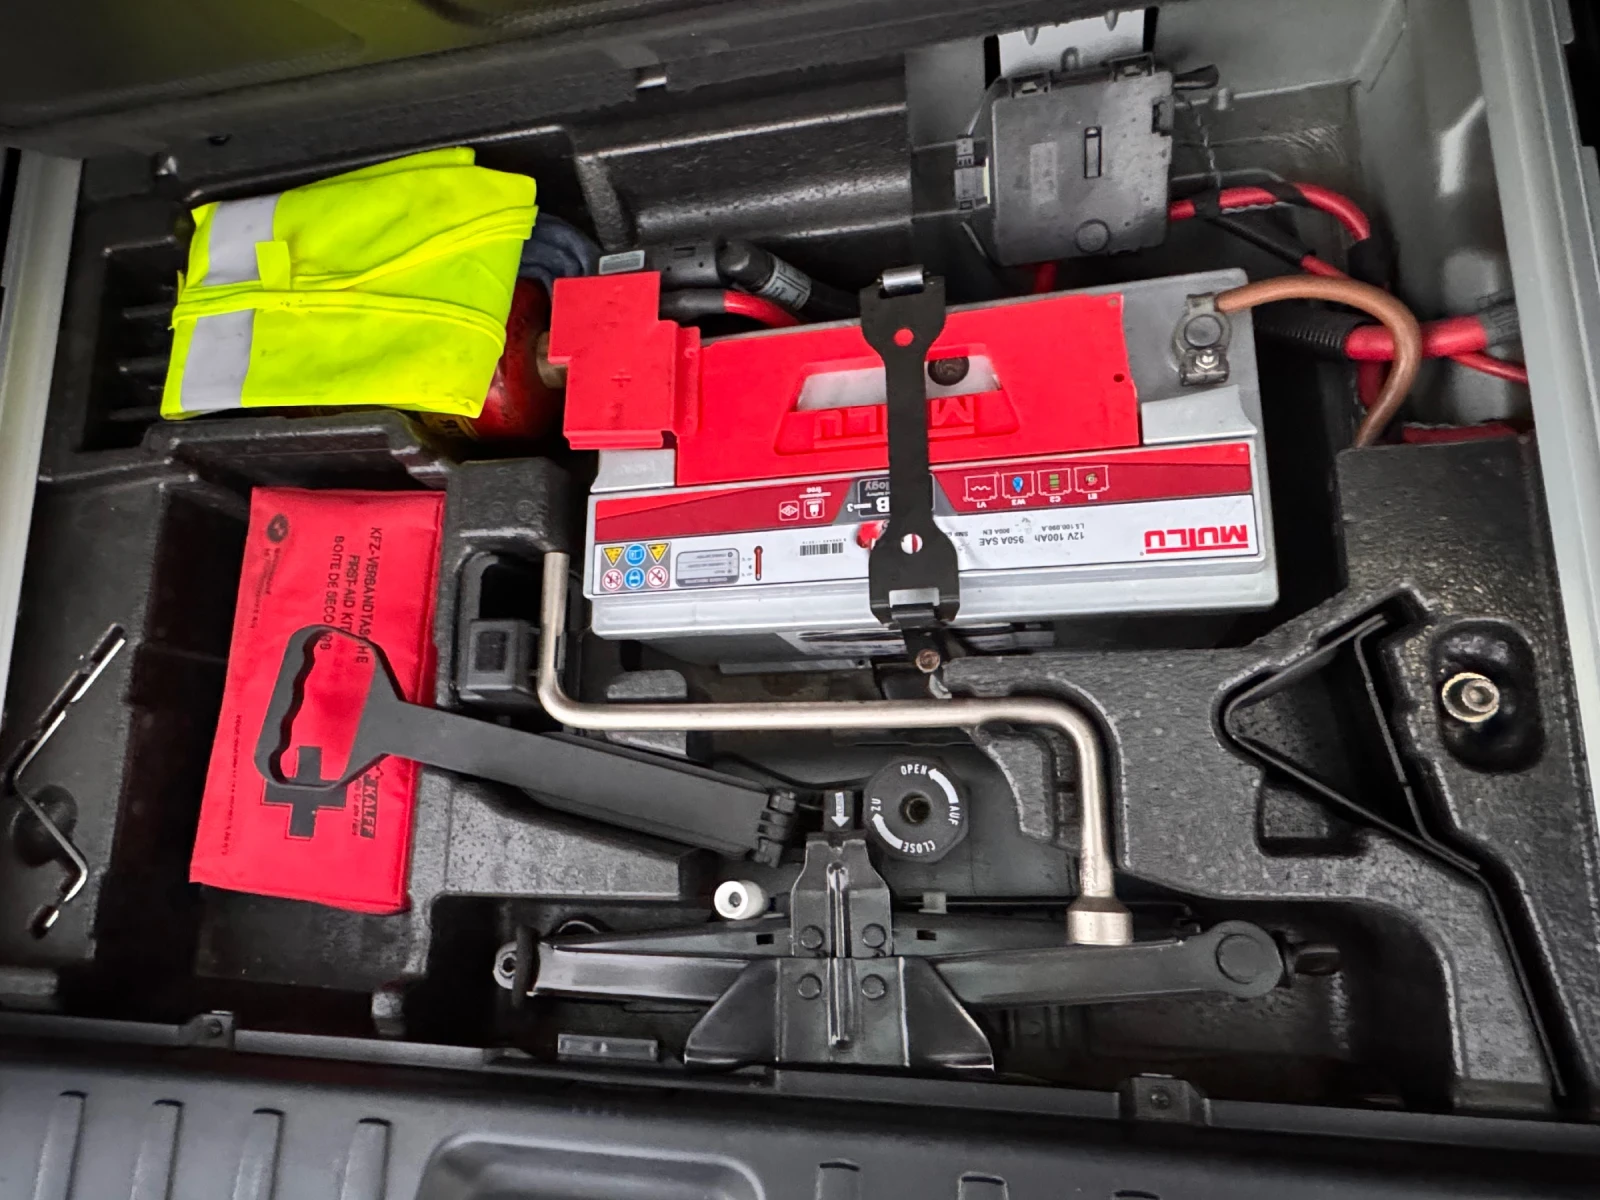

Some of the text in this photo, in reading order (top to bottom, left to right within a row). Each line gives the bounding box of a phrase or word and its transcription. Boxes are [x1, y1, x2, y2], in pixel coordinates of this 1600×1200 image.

[813, 396, 975, 450] MLU
[979, 535, 1025, 548] 950A SAE
[983, 529, 993, 537] EN
[1034, 531, 1085, 546] 12V 100Ah
[1144, 524, 1249, 555] MUTLU
[327, 573, 340, 588] DE
[344, 555, 361, 609] FIRST-AID
[355, 527, 382, 666] KFZ-VERBANDTASHE
[319, 590, 338, 651] SECORS
[900, 763, 928, 776] OPEN
[362, 785, 377, 834] KALFF
[870, 797, 882, 812] ZU
[948, 805, 961, 826] AUF
[902, 839, 936, 854] CLOSE
